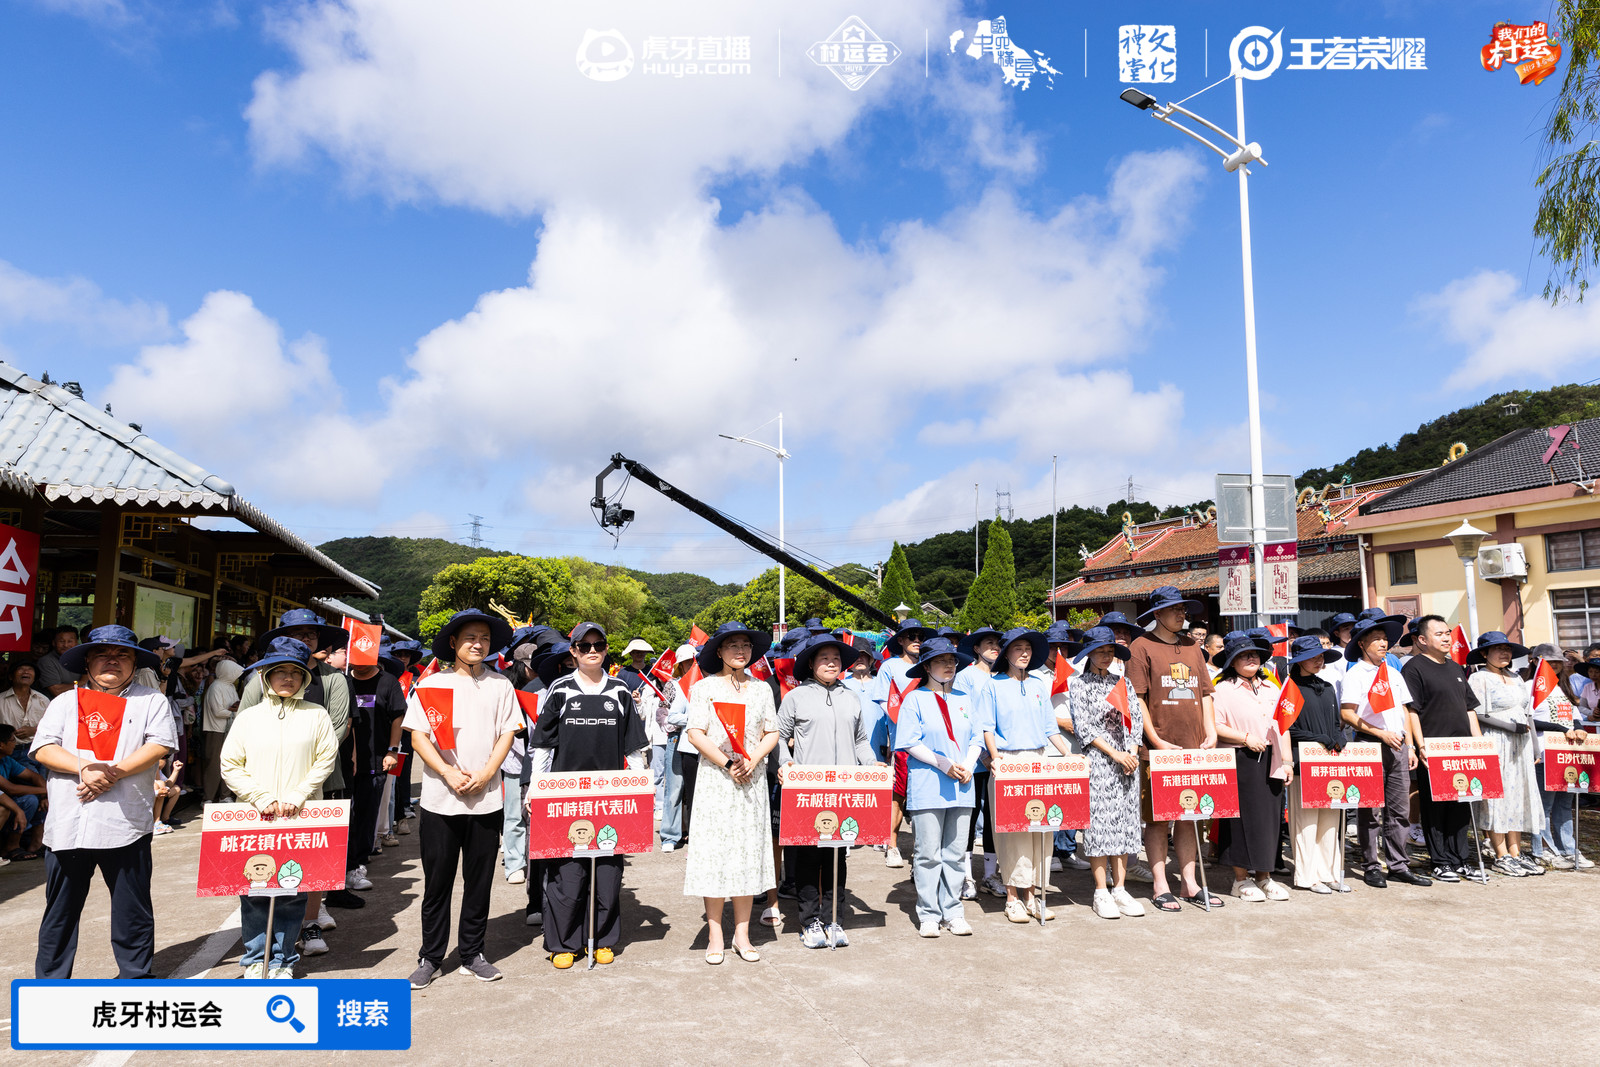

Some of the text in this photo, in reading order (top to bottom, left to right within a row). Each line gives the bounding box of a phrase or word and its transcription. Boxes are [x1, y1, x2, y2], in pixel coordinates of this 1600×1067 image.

[1442, 758, 1487, 771] 蚂蚁代表队
[1557, 752, 1596, 766] 白沙代表队
[1310, 766, 1374, 777] 展茅街道代表队
[1162, 773, 1228, 787] 东港街道代表队
[1003, 782, 1082, 797] 沈家门街道代表队
[796, 793, 878, 808] 东极镇代表队
[547, 799, 639, 818] 虾峙镇代表队
[219, 831, 329, 853] 桃花镇代表队
